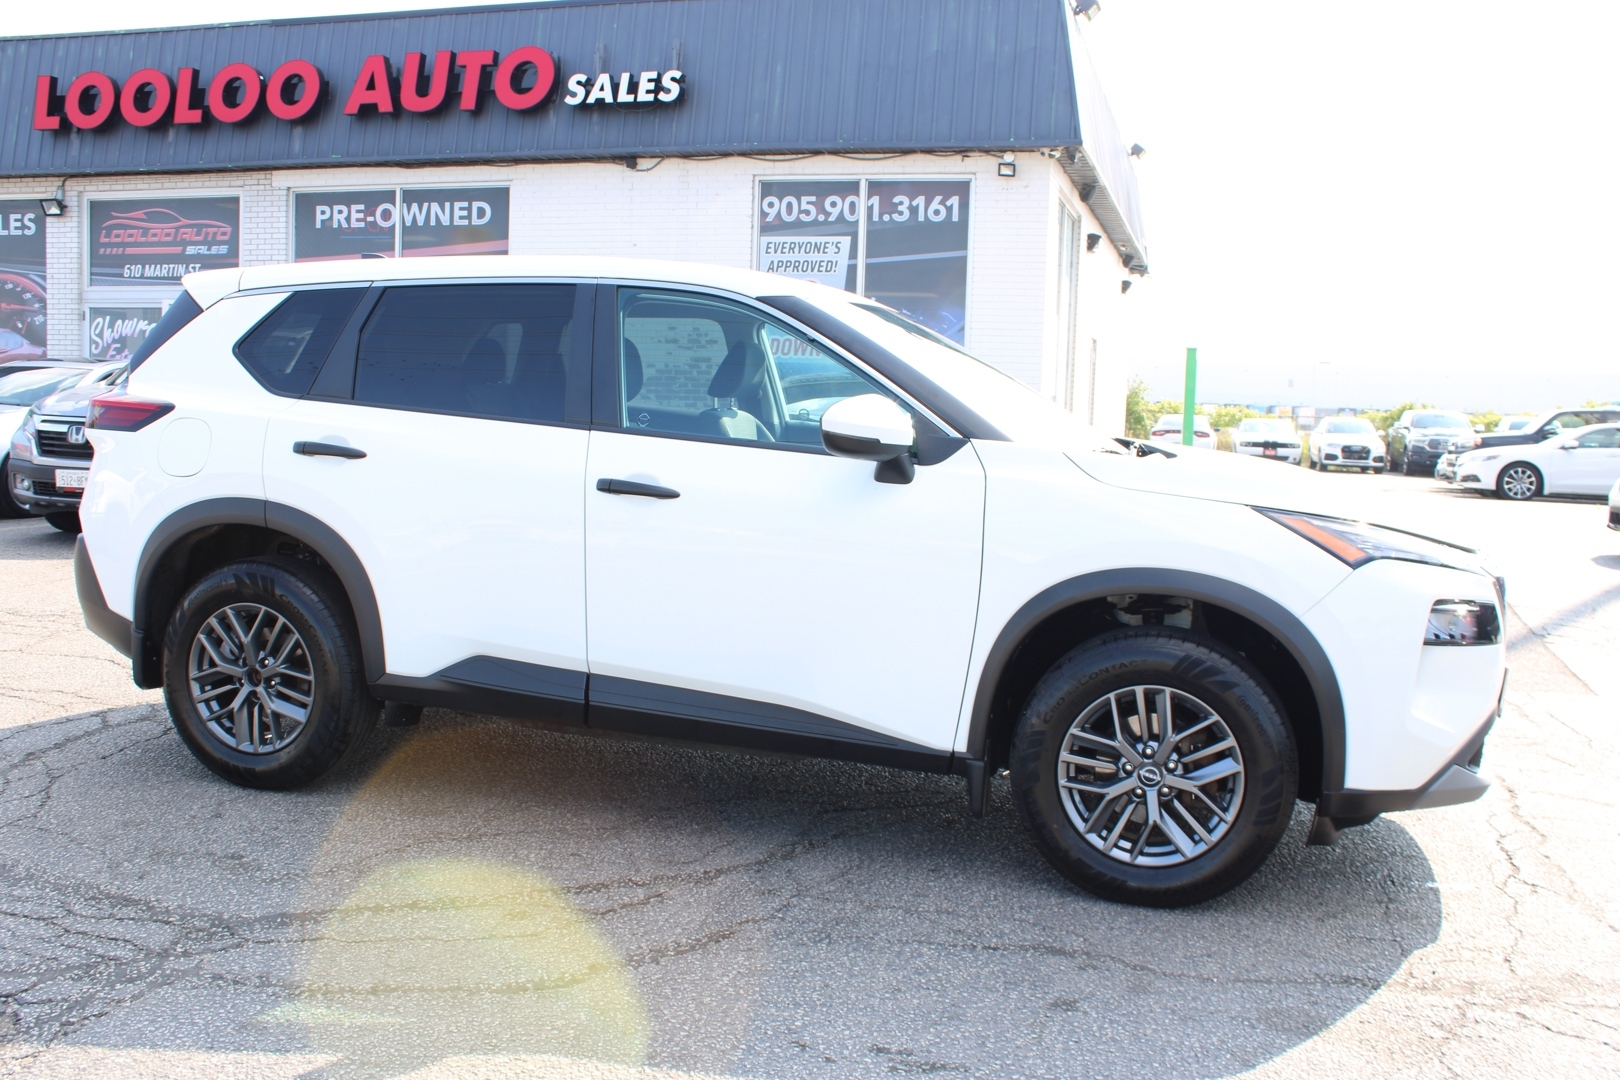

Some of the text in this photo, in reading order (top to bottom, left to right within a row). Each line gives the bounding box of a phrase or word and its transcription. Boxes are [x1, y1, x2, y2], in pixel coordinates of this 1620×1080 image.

[34, 46, 683, 131] LOOLOO AUTO SALES
[315, 201, 492, 228] PRE-OWNED
[762, 195, 960, 223] 905.901.3161
[99, 227, 232, 243] LOOLOO AUTO
[185, 245, 229, 255] SALES
[765, 241, 842, 255] EVERYONE'S
[123, 264, 142, 278] 610
[144, 263, 186, 277] MARTIN
[767, 260, 838, 274] APPROVED!
